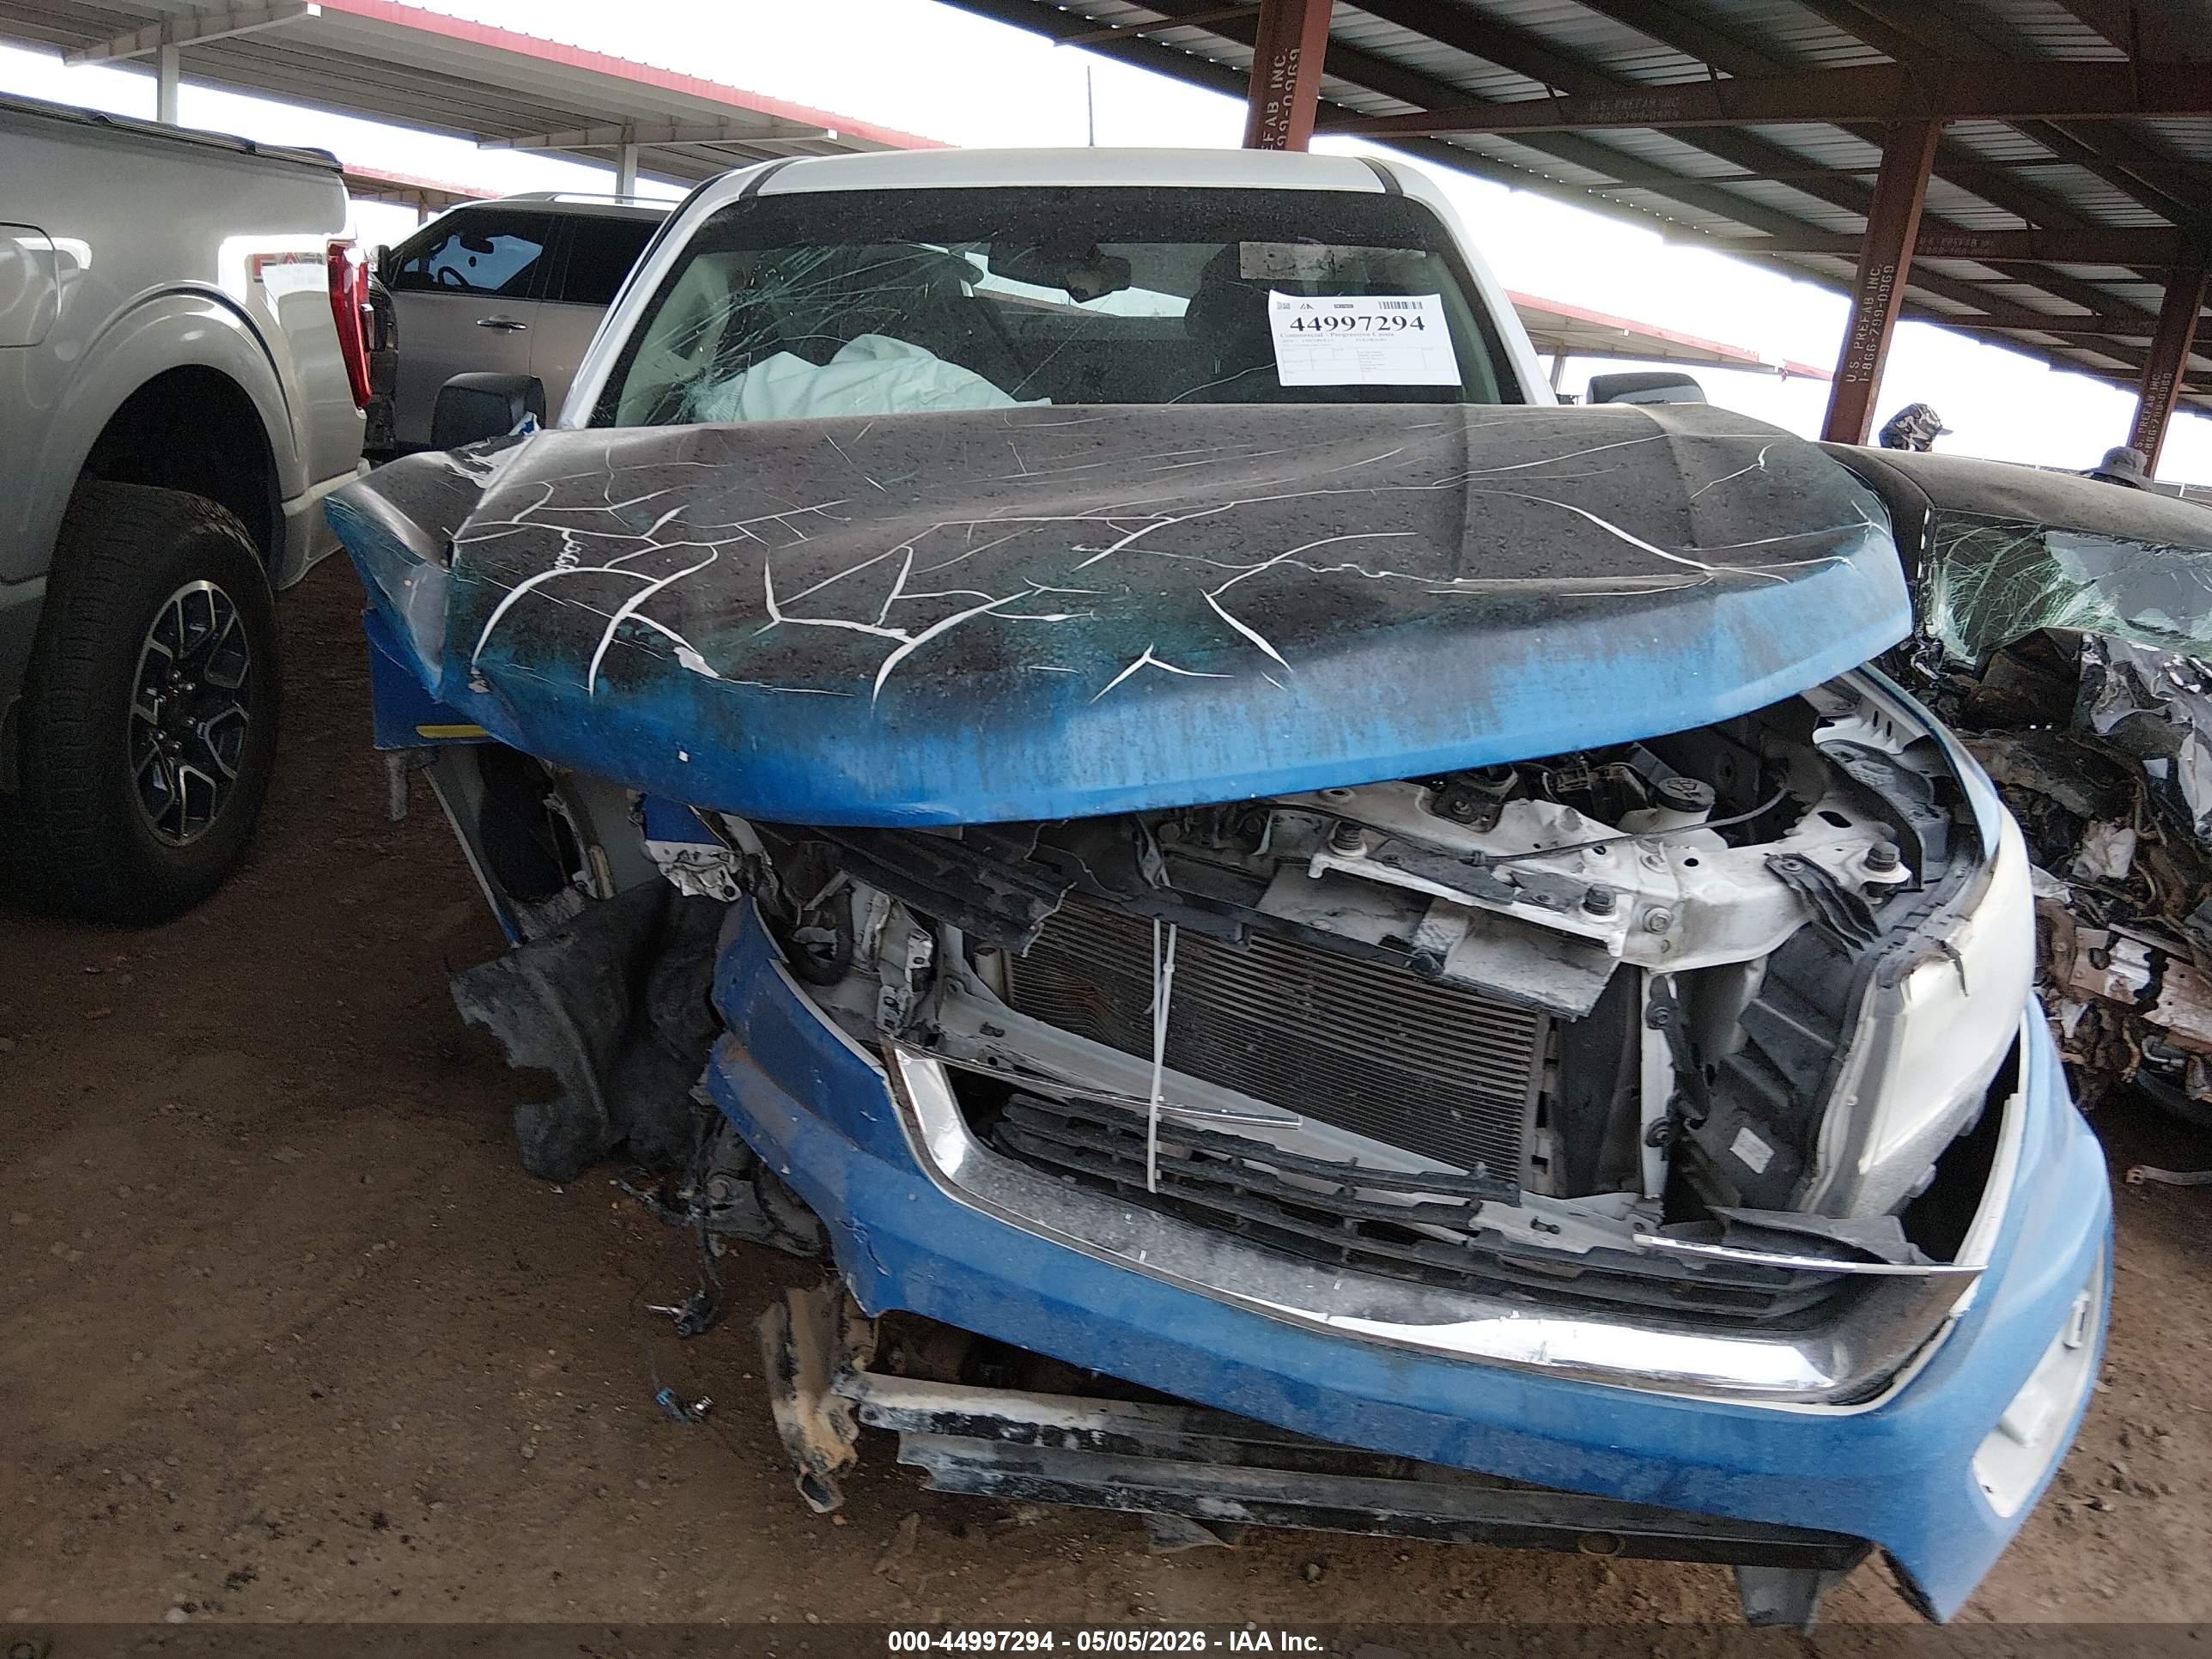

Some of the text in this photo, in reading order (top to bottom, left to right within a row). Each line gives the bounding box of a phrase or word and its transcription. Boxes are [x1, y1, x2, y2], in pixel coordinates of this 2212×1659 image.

[1271, 47, 1288, 88] INC.
[1289, 315, 1425, 332] 44997294
[1854, 297, 1875, 349] PREFAB
[1858, 264, 1894, 382] 1-866-799-0969
